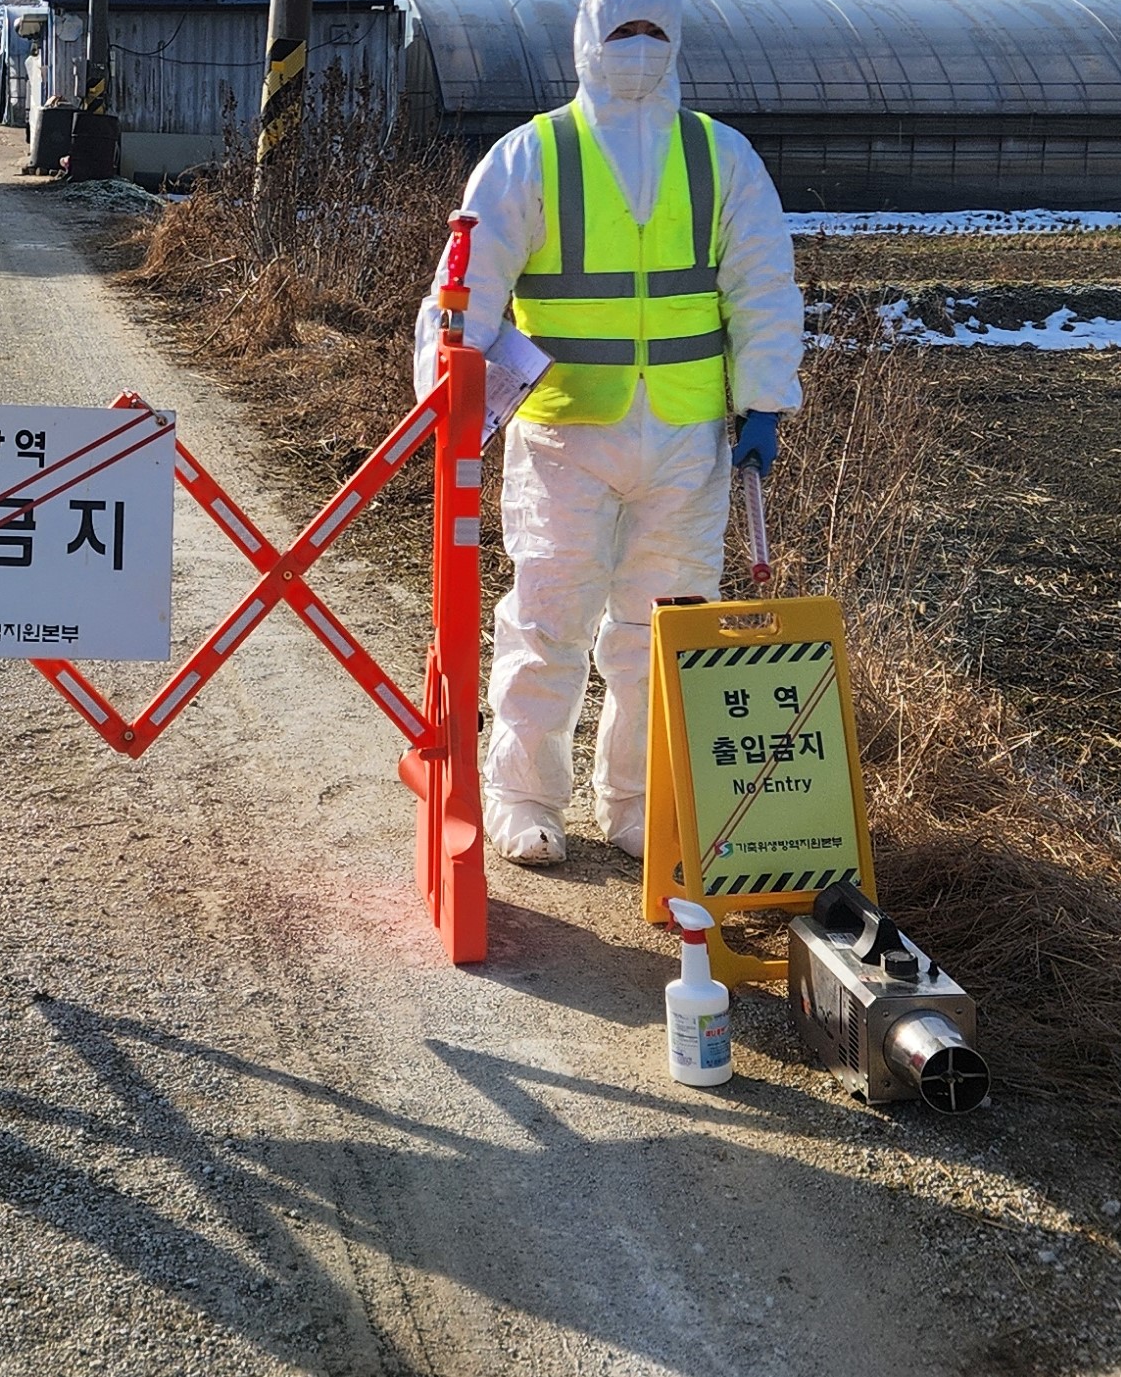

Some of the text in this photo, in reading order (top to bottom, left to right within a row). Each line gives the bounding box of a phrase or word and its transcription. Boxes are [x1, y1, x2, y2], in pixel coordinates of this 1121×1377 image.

[712, 731, 824, 765] 출입금지
[733, 777, 812, 795] No Entry
[736, 837, 842, 853] 가축위생방역지원본부
